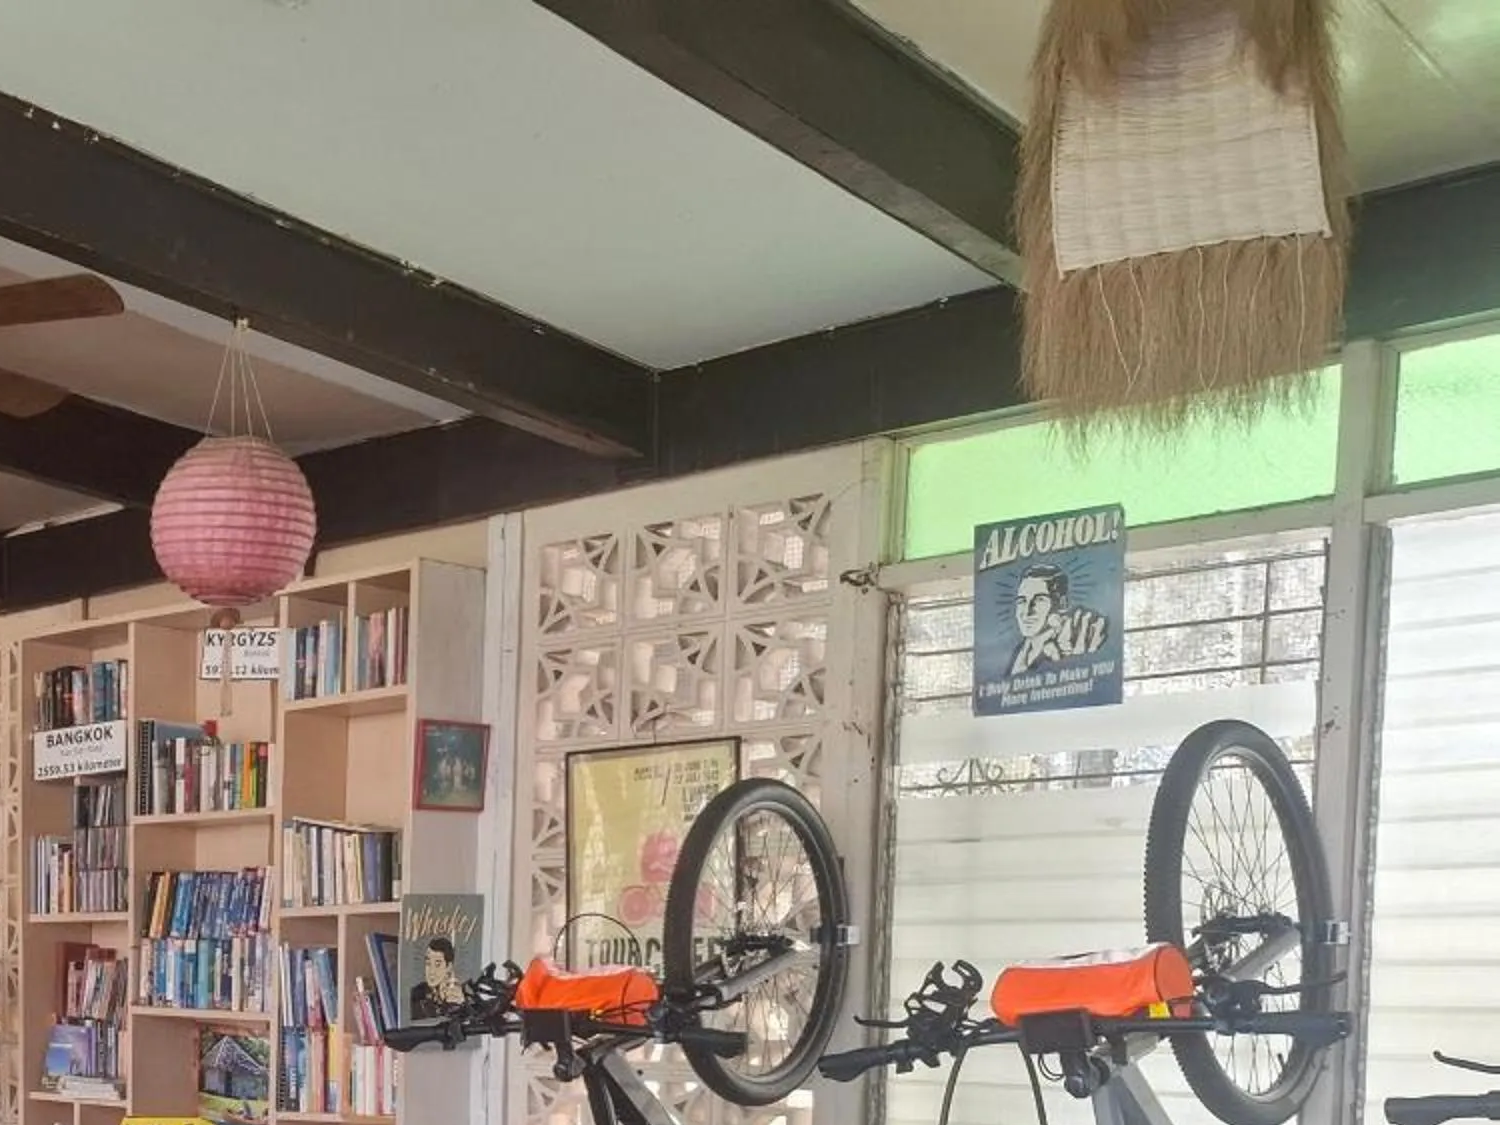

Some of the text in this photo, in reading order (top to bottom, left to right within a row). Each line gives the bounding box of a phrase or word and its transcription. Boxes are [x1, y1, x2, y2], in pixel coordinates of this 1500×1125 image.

[980, 509, 1120, 570] ALCOHOL!
[1013, 674, 1042, 692] Drink
[1045, 671, 1057, 686] To
[1059, 667, 1090, 683] Make
[1091, 660, 1116, 677] YOU
[1001, 692, 1029, 708] More
[46, 725, 113, 749] BANGKOK
[405, 903, 478, 944] Whiskey
